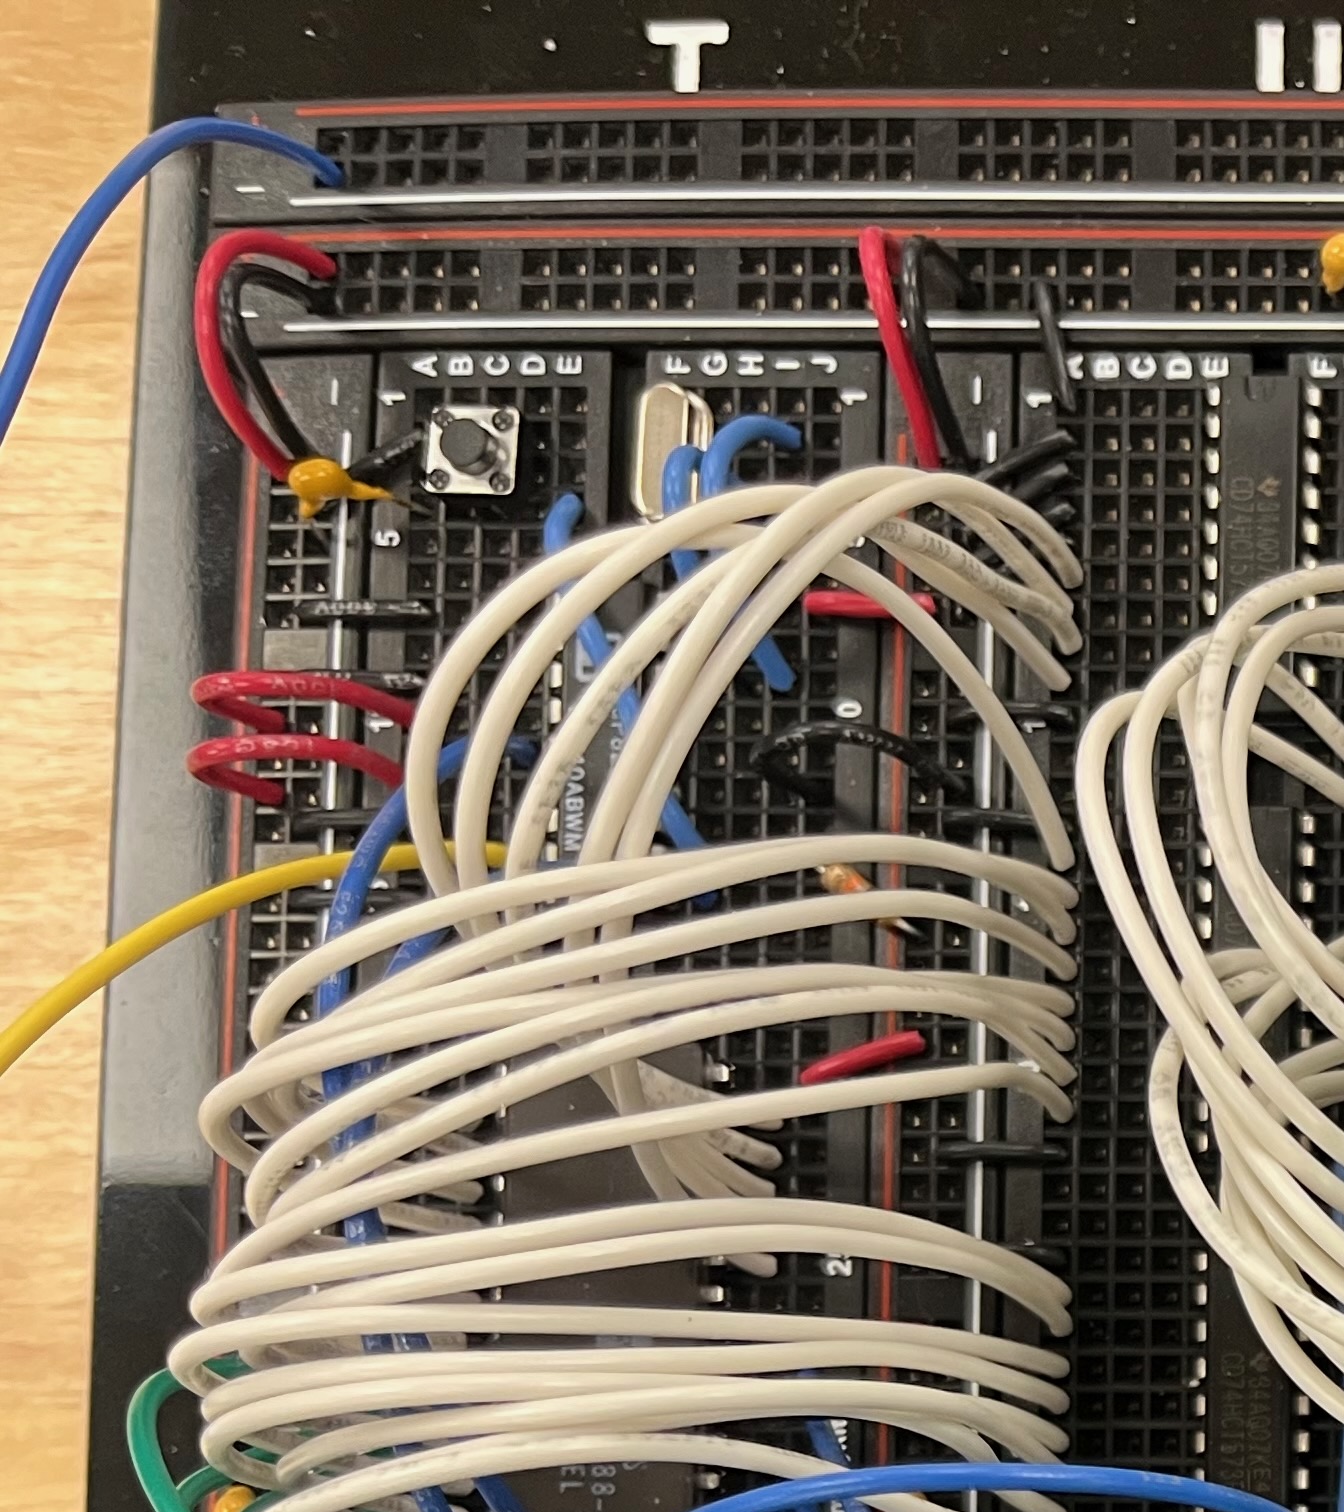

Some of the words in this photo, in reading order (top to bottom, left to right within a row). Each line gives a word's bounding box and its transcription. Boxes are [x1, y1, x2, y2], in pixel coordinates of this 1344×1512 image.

[646, 21, 730, 93] T
[380, 391, 407, 407] 1
[840, 388, 868, 406] 1
[374, 528, 401, 548] 5
[1229, 476, 1256, 598] CD74HCT57
[1257, 501, 1281, 580] 34AQ07
